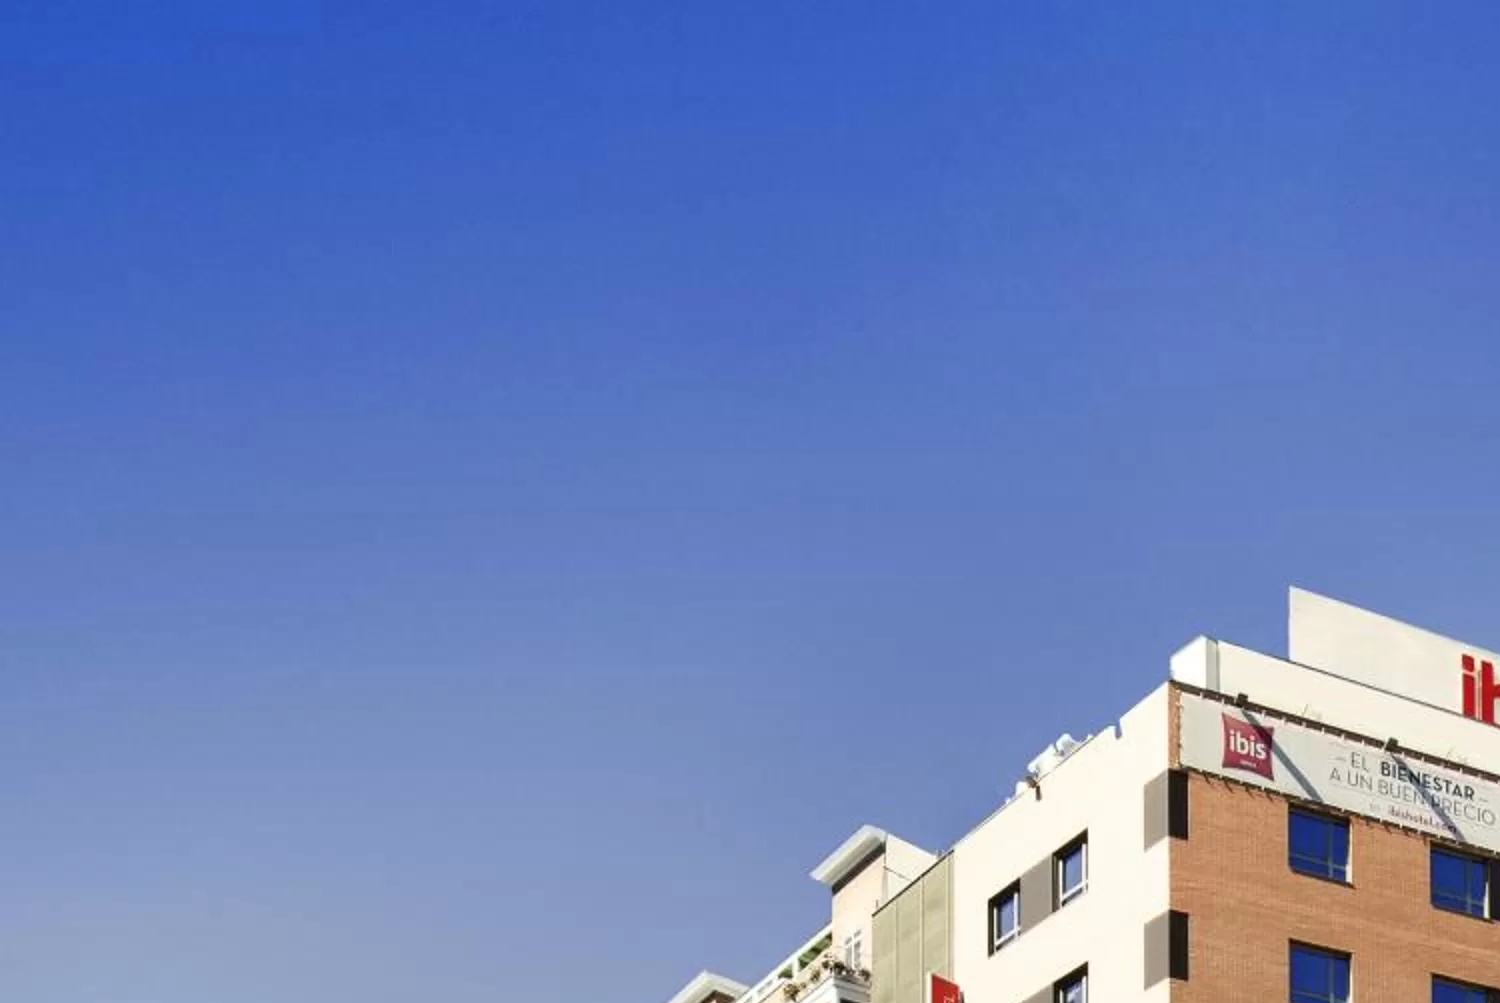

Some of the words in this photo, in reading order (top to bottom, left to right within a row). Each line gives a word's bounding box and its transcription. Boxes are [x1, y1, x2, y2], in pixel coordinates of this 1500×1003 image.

[1229, 729, 1267, 760] ibis
[1329, 767, 1341, 782] A
[1347, 771, 1374, 792] UN
[1378, 780, 1427, 805] BUEN
[1431, 792, 1497, 827] PRECIO
[1350, 751, 1370, 773] EL
[1381, 761, 1475, 801] BIENESTAR
